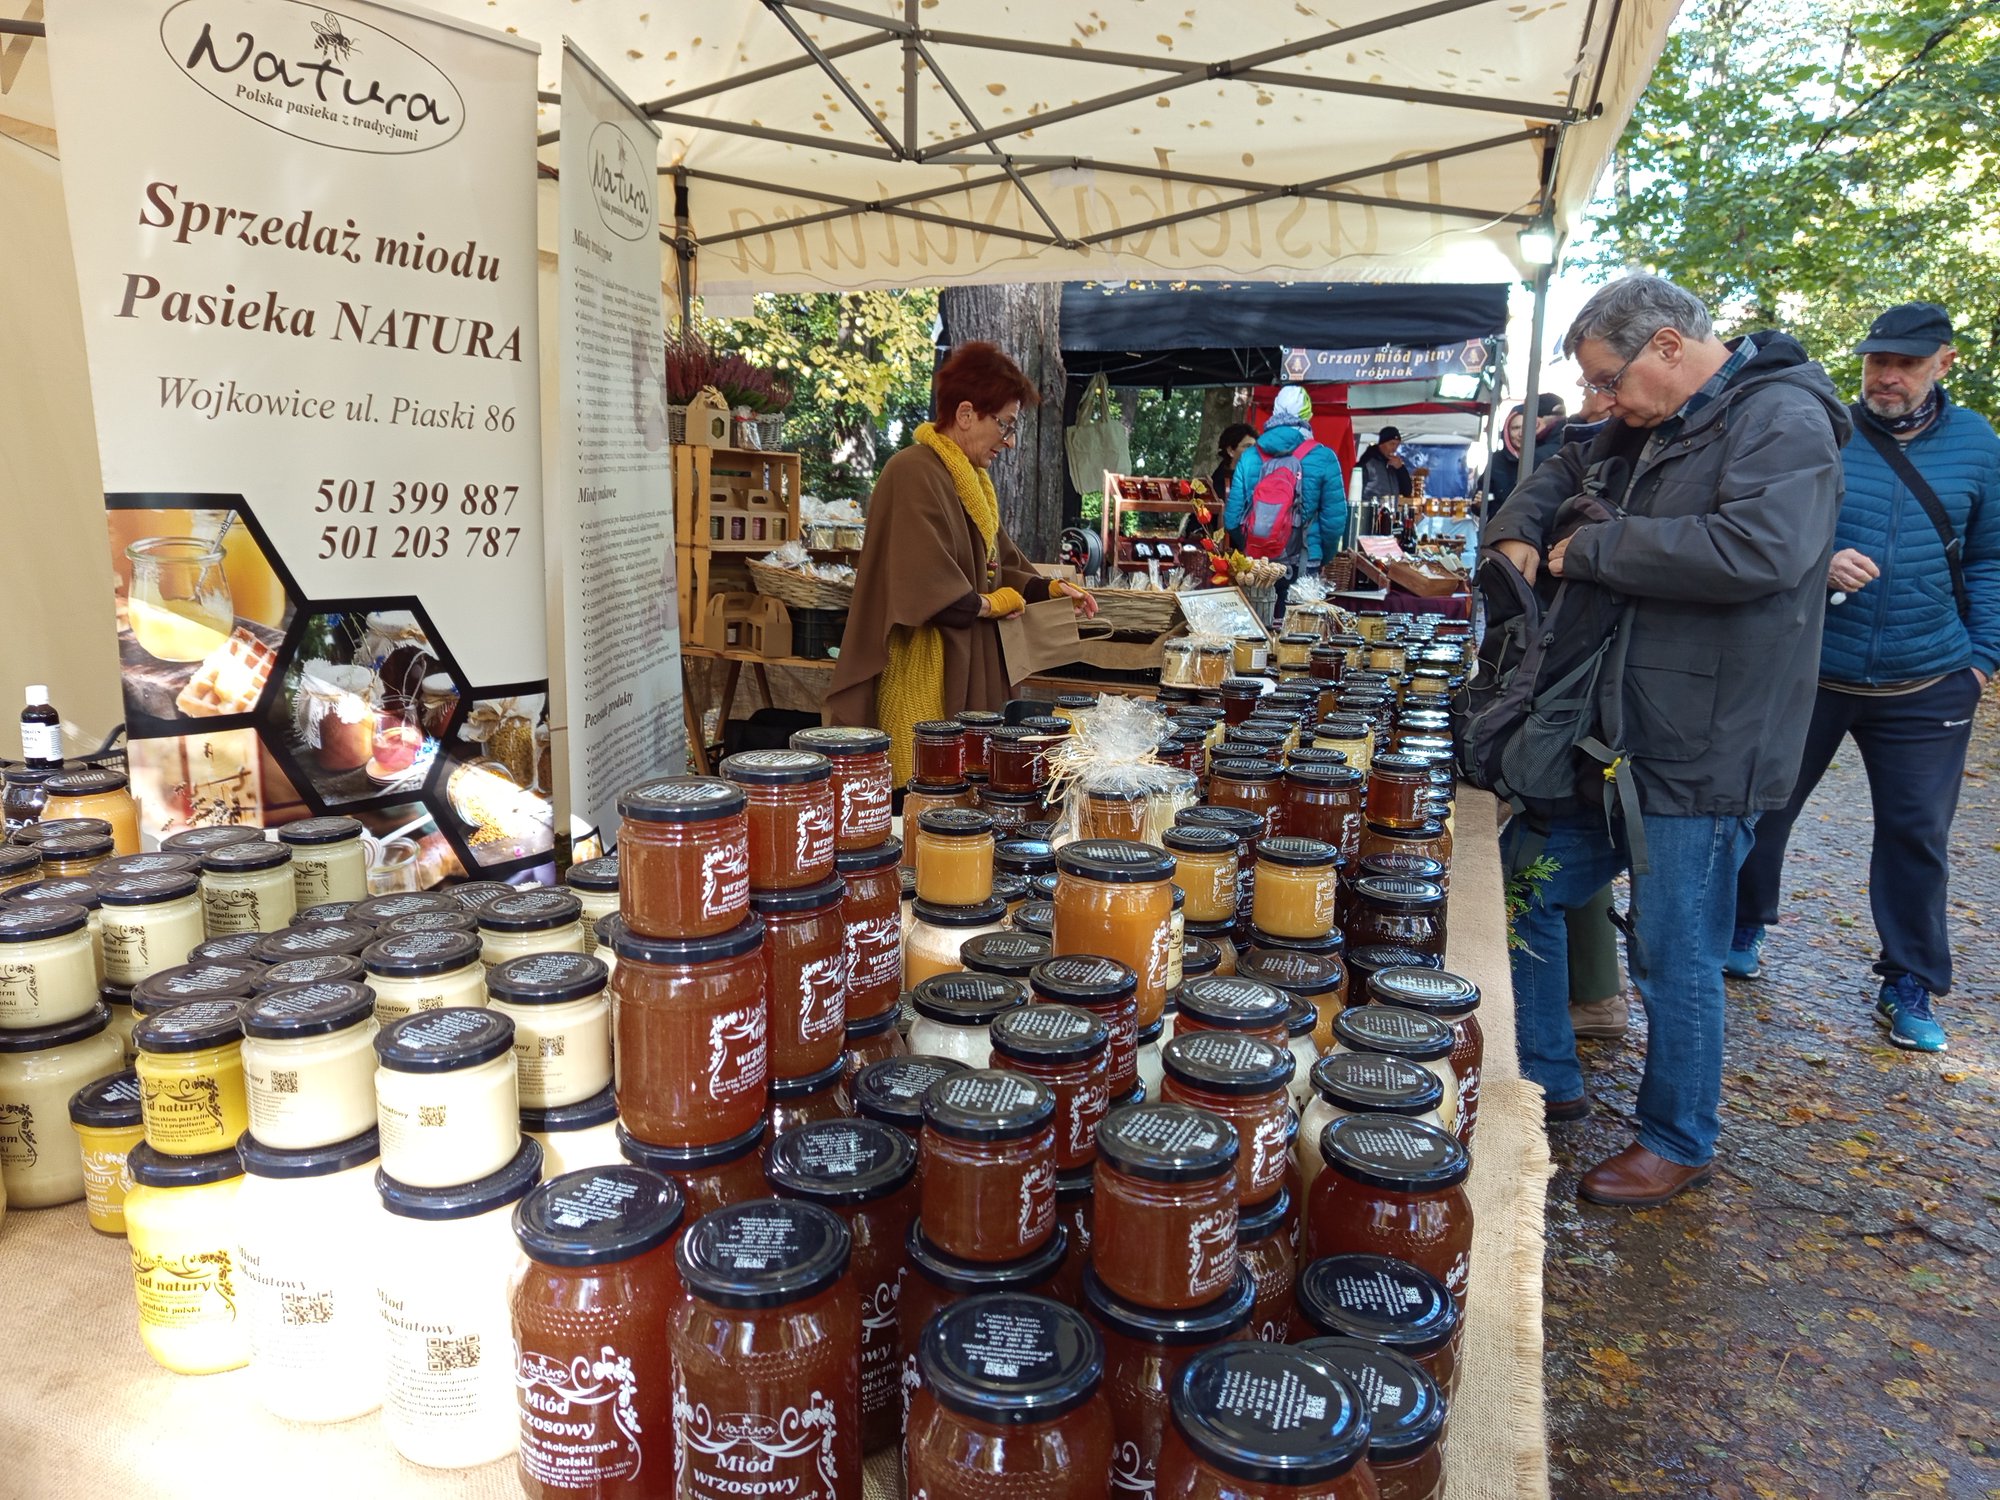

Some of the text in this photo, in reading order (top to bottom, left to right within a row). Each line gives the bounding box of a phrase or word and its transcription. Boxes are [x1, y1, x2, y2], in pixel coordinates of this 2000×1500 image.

[186, 22, 450, 126] Natura
[235, 83, 419, 142] Polska pasieka z tradycjami
[593, 149, 649, 214] Natura
[138, 181, 501, 282] Sprzedaż miodu
[113, 272, 522, 362] Pasieka NATURA
[1317, 349, 1455, 367] Grzany miód pitny
[1355, 364, 1413, 379] trójniak
[156, 376, 516, 433] Wojkowice ul. Piaski 86
[315, 479, 519, 516] 501 399 887
[318, 526, 521, 559] 501 203 787
[867, 793, 887, 804] Miód
[159, 1101, 204, 1112] natury
[135, 1271, 211, 1294] Cud natury
[142, 1301, 201, 1315] produkt polski
[523, 1357, 569, 1379] Natura
[525, 1388, 570, 1415] Miód
[716, 1420, 776, 1436] Natura
[541, 1439, 618, 1455] ekologicznych
[555, 1456, 593, 1467] polski
[715, 1453, 776, 1473] Miód
[693, 1468, 800, 1495] wrzosowy
